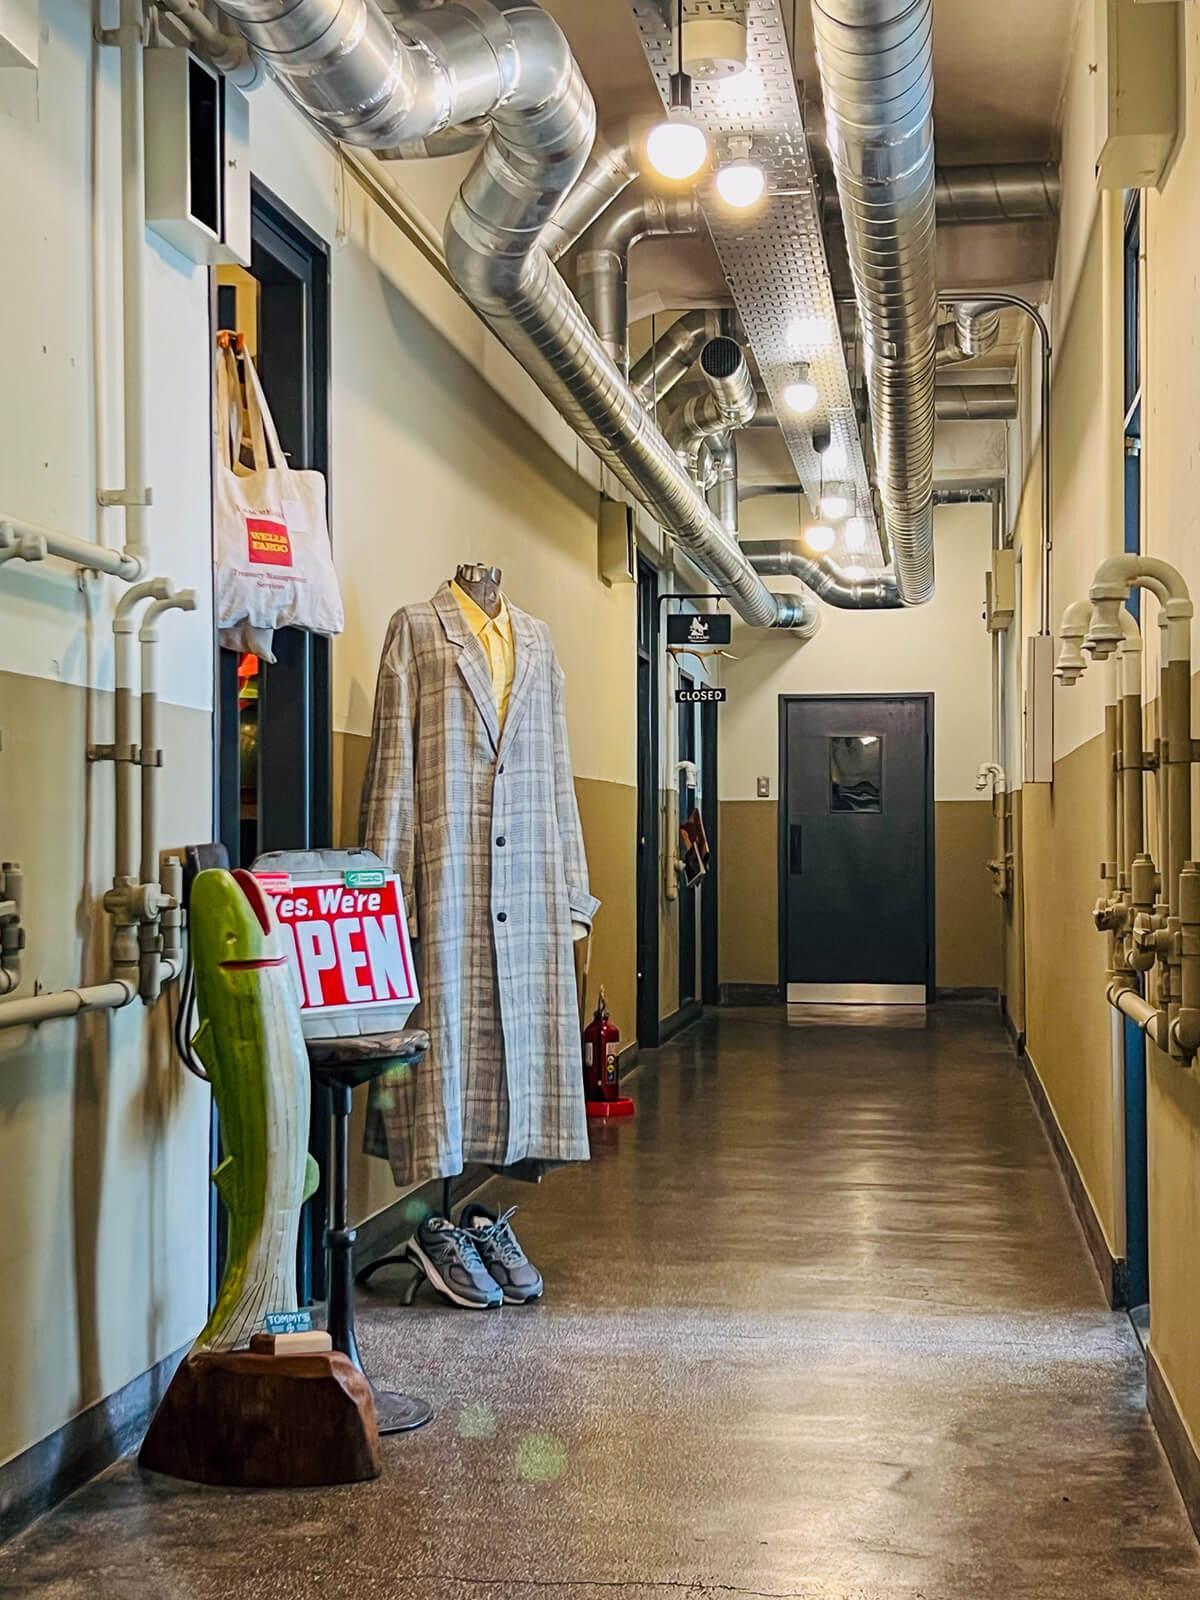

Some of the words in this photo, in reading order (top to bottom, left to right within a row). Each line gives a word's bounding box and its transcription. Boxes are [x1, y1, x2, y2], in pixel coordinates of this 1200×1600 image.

[250, 532, 288, 544] WELLS
[252, 541, 288, 552] FARGO
[679, 691, 722, 700] CLOSED
[317, 887, 381, 915] We're
